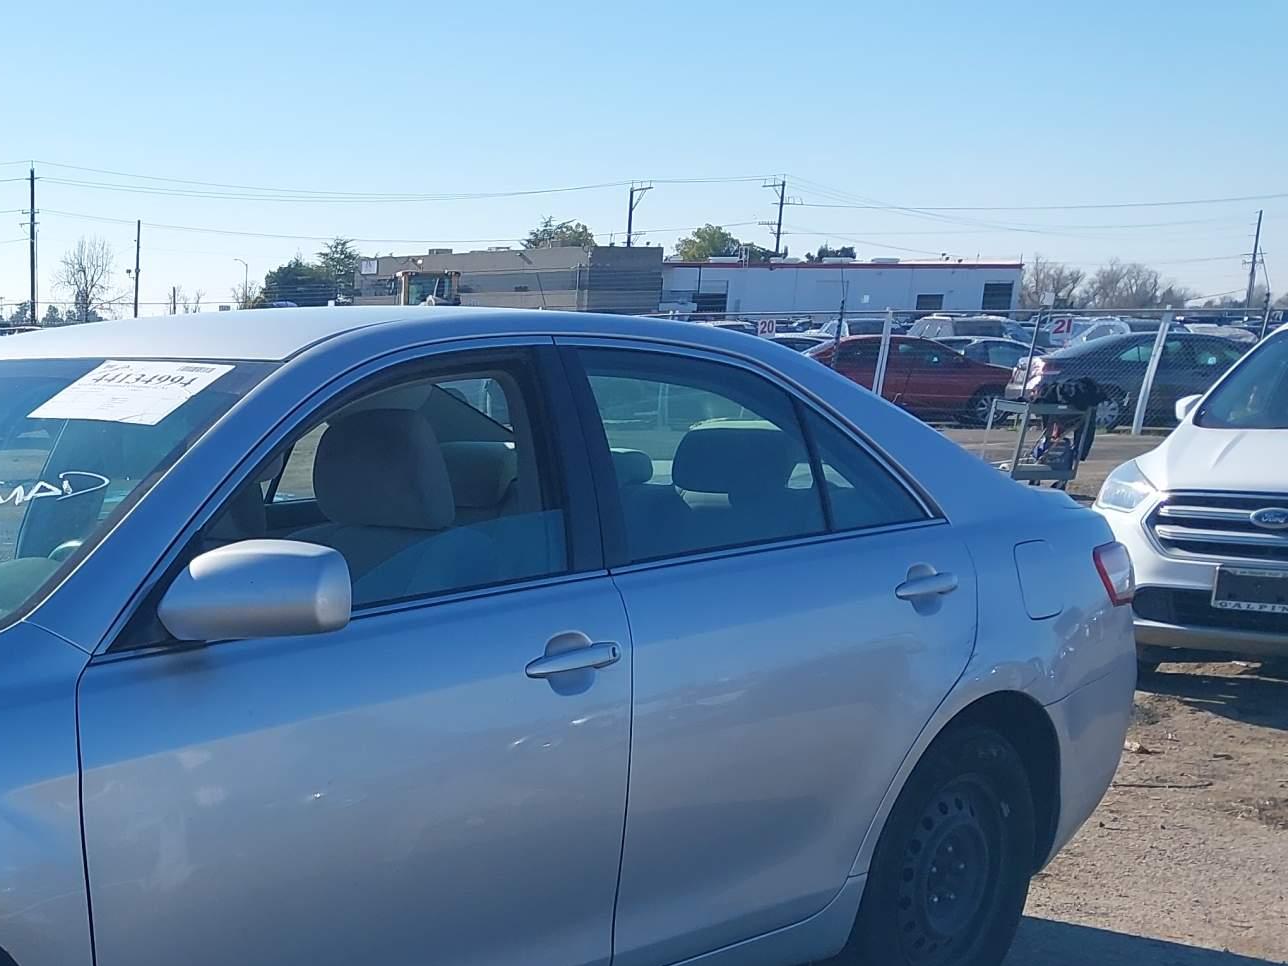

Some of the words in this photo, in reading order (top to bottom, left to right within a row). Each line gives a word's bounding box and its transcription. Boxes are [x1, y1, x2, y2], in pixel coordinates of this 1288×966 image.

[760, 320, 775, 334] 20
[1053, 319, 1072, 334] 21
[92, 372, 198, 387] 44134994
